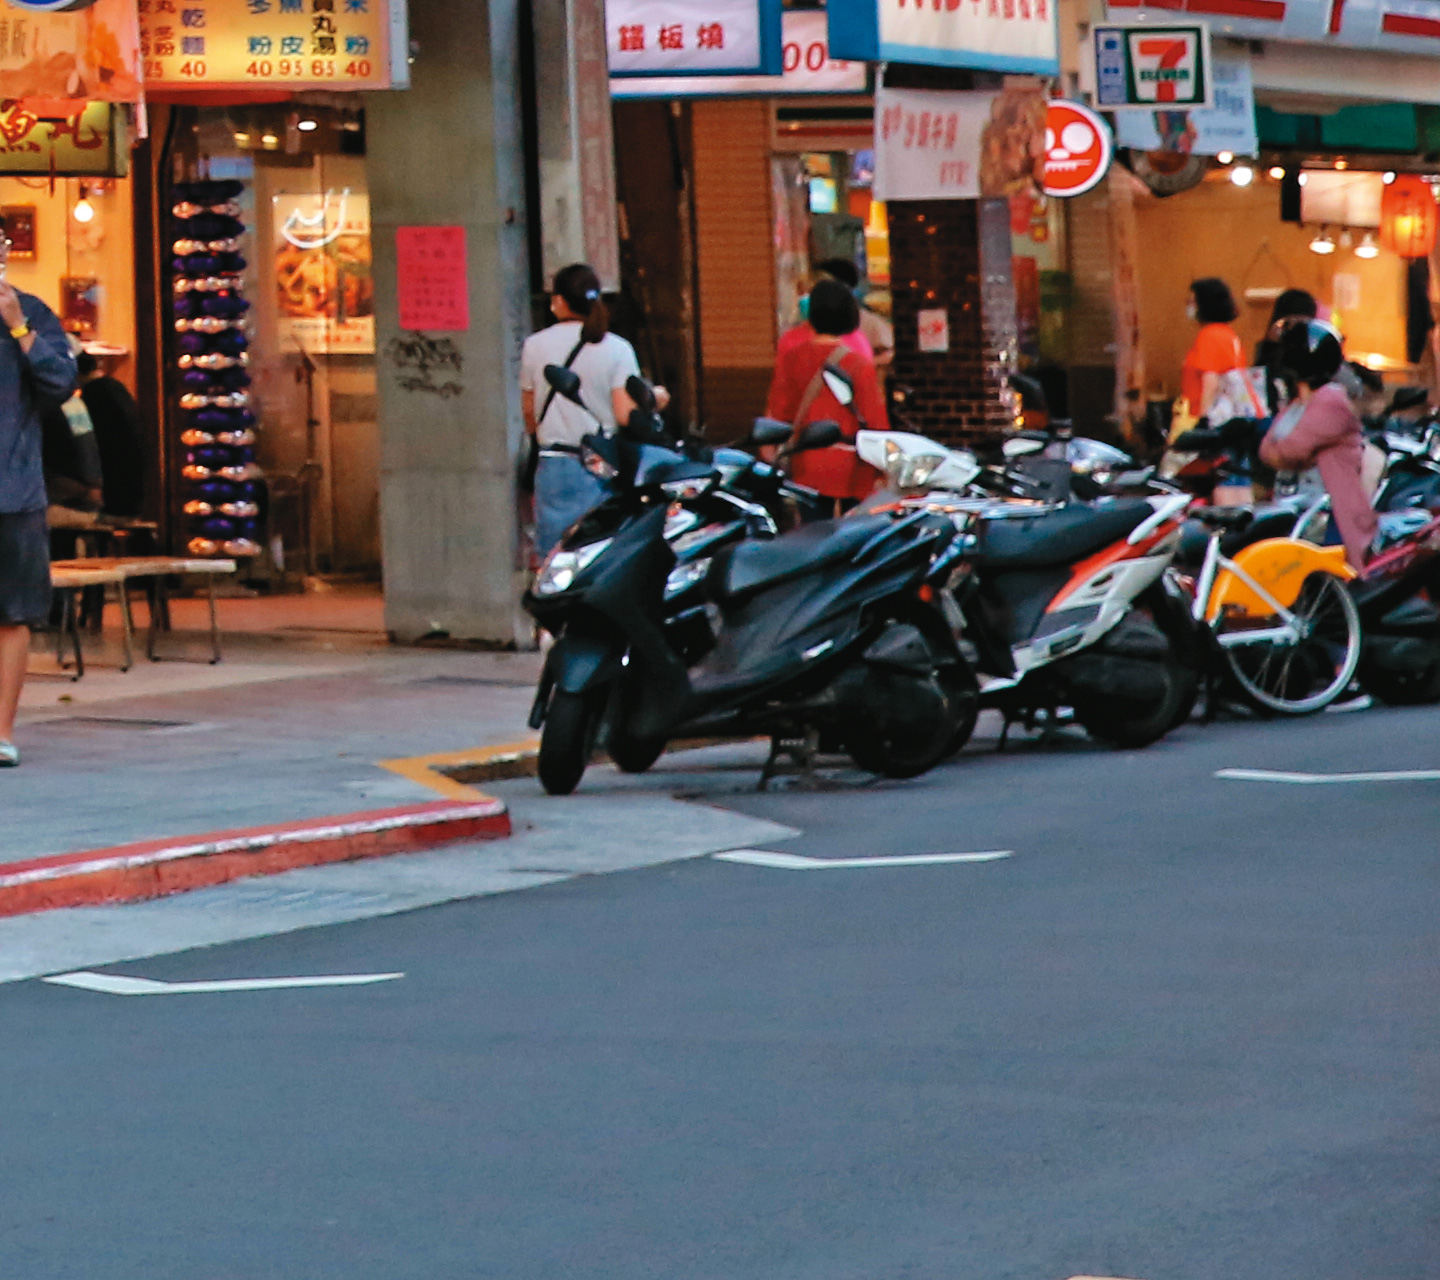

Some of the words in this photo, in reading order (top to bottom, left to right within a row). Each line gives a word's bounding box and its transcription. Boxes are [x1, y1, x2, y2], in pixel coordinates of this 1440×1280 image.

[180, 60, 206, 77] 40
[246, 60, 272, 77] 40
[279, 60, 303, 76] 95
[345, 60, 371, 77] 40
